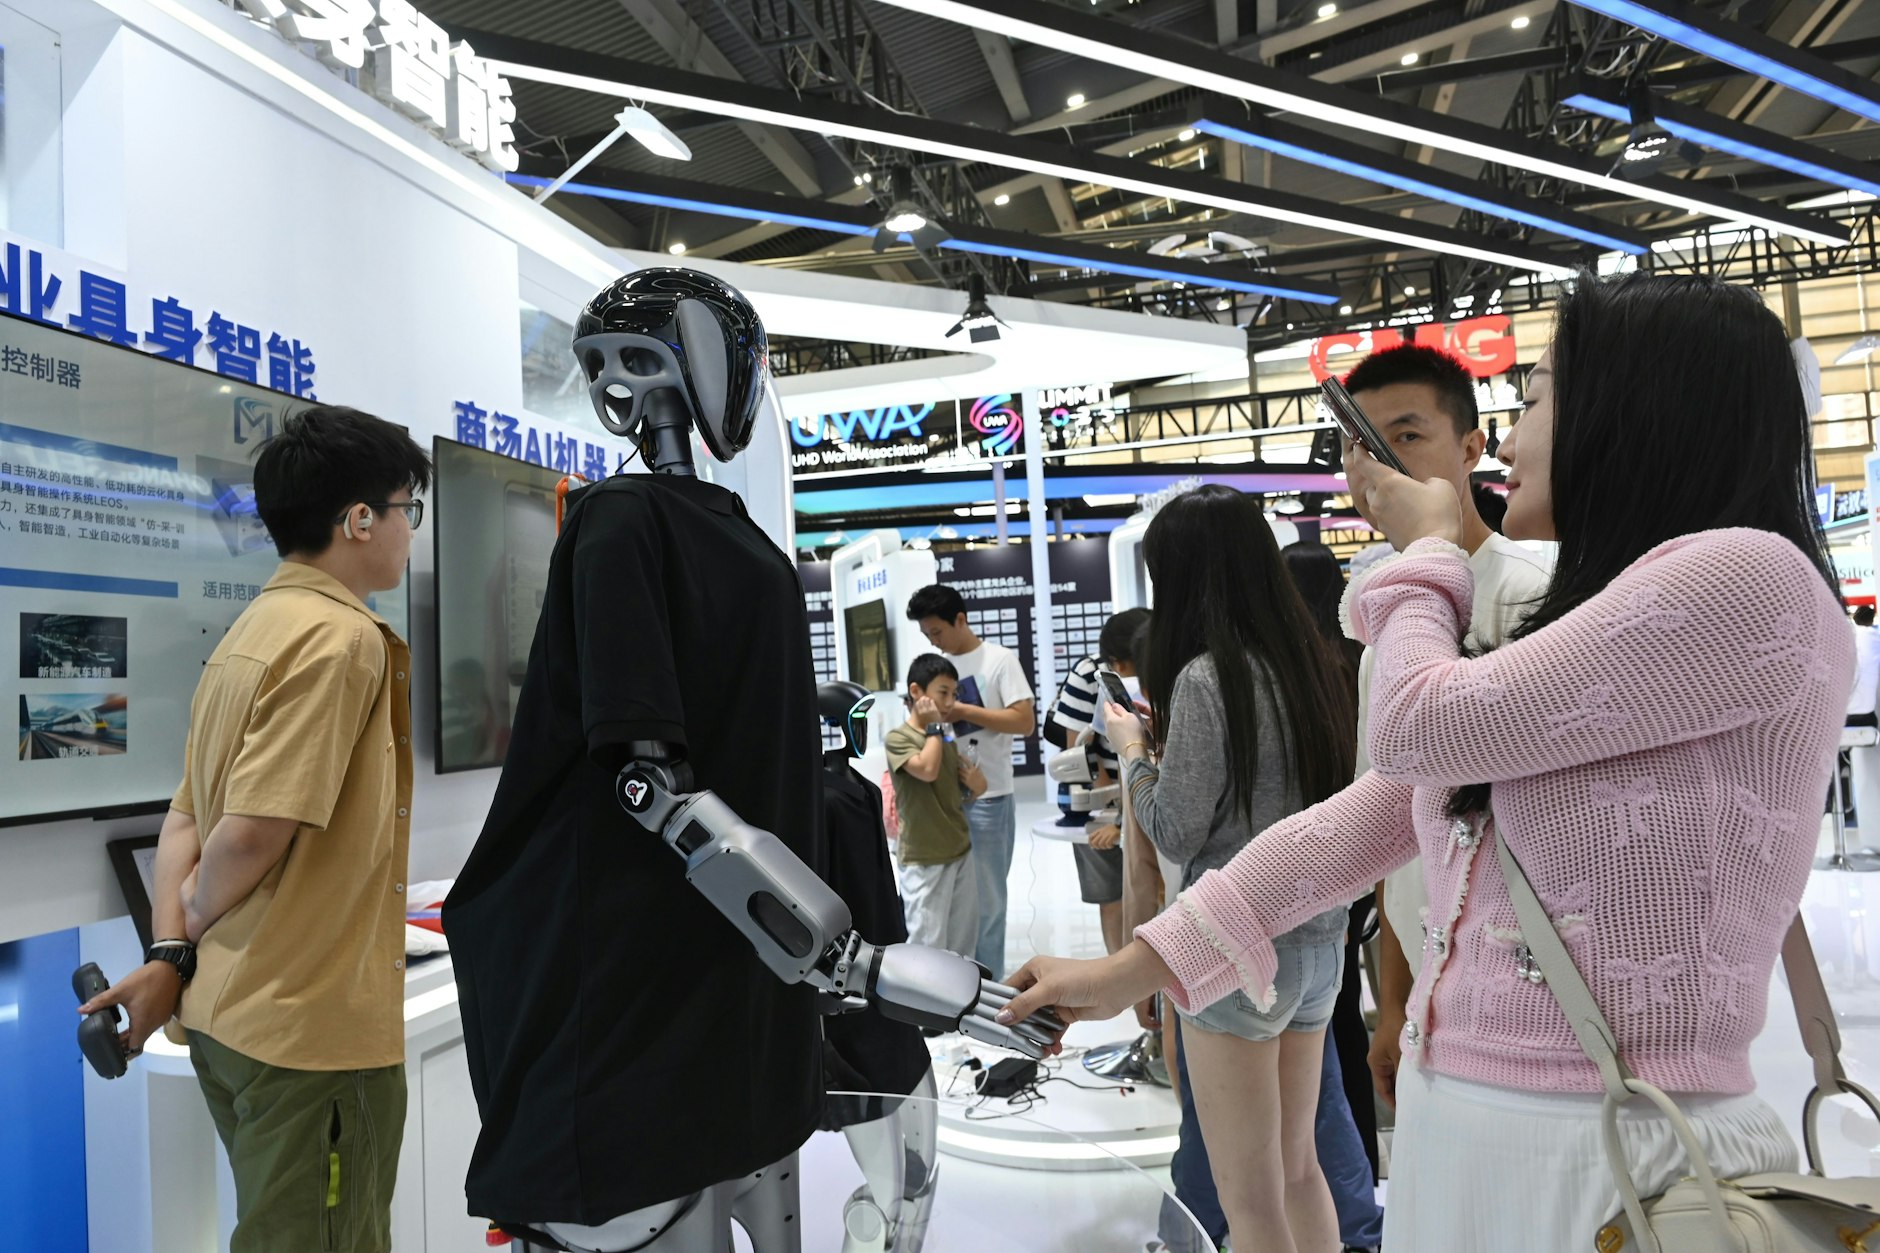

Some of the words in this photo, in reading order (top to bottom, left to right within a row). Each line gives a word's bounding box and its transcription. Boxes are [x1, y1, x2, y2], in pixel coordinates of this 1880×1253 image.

[1, 344, 82, 390] 控制器
[792, 452, 820, 467] UHD
[202, 580, 261, 601] 适用范围
